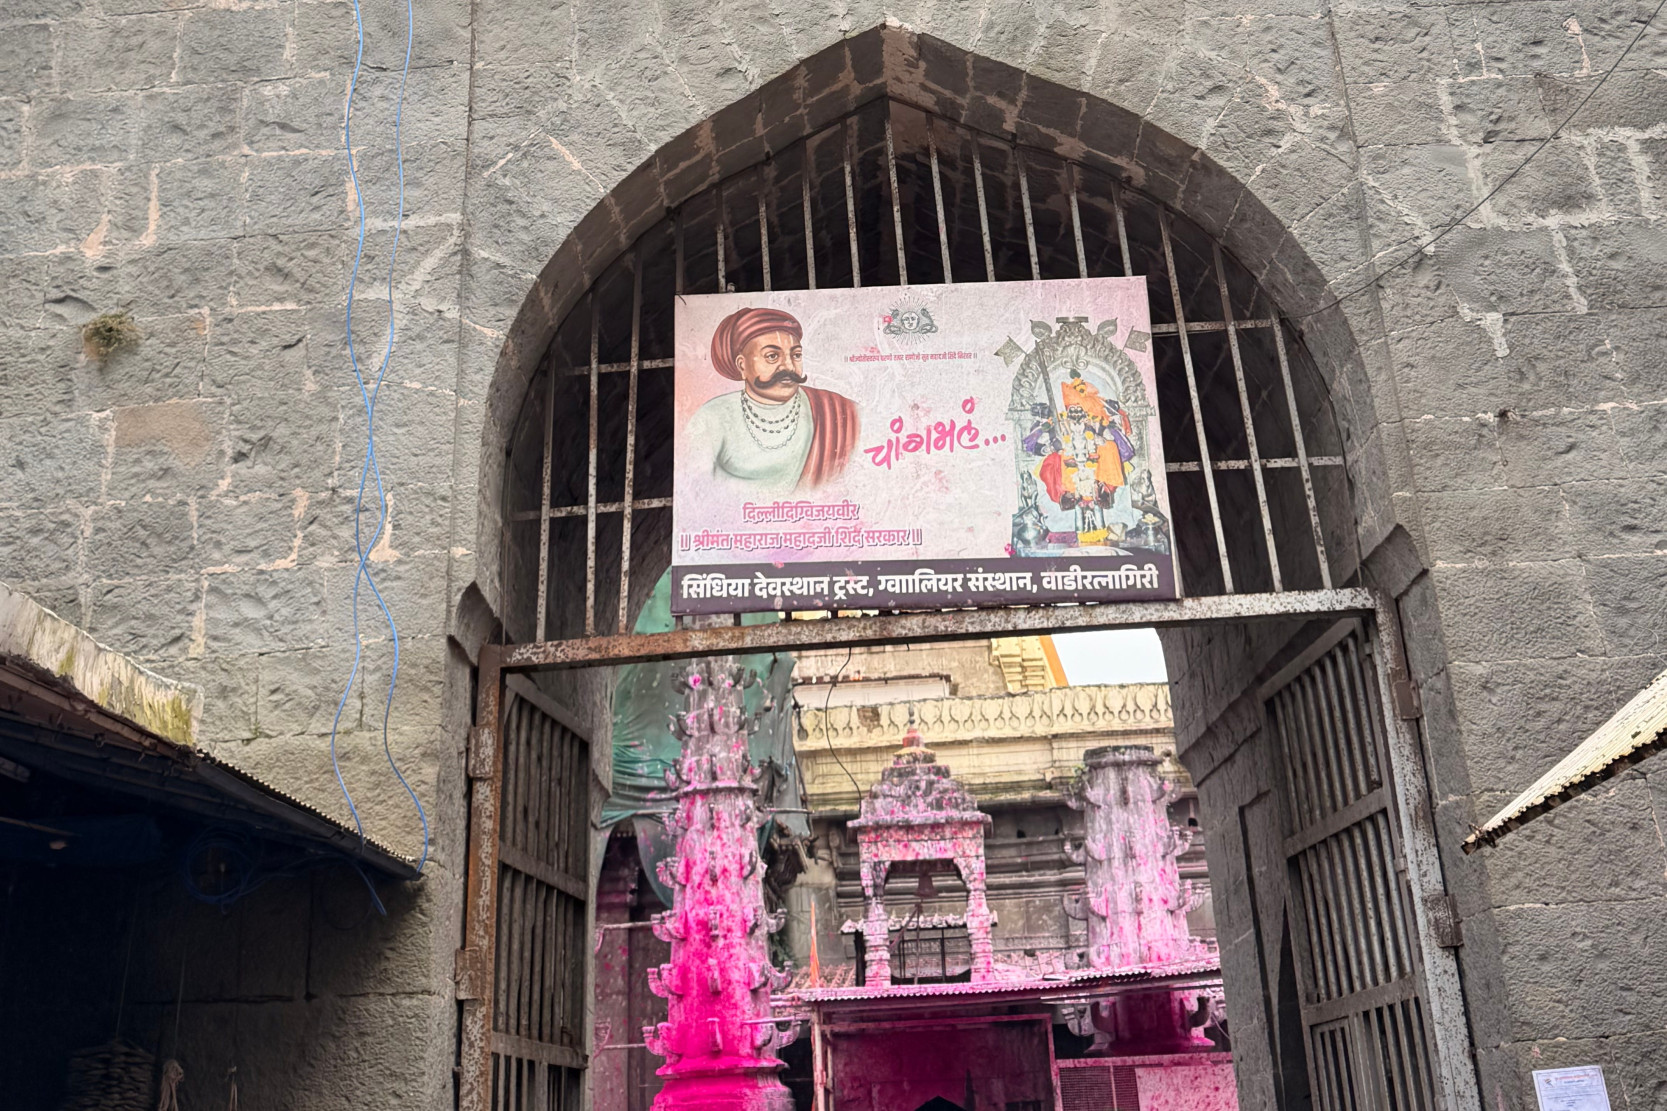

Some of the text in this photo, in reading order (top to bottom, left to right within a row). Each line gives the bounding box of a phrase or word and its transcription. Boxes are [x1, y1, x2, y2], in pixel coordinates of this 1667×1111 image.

[692, 529, 732, 551] श्रीमंत
[733, 531, 782, 551] महाराज
[782, 526, 834, 550] महादजी
[864, 529, 909, 546] सरकार
[681, 573, 751, 599] सिंधिया
[753, 571, 830, 599] देवस्थान
[833, 575, 874, 600] ट्रस्ट,
[966, 567, 1038, 593] संस्थान,
[1041, 563, 1159, 591] वाडीरत्नागिरी
